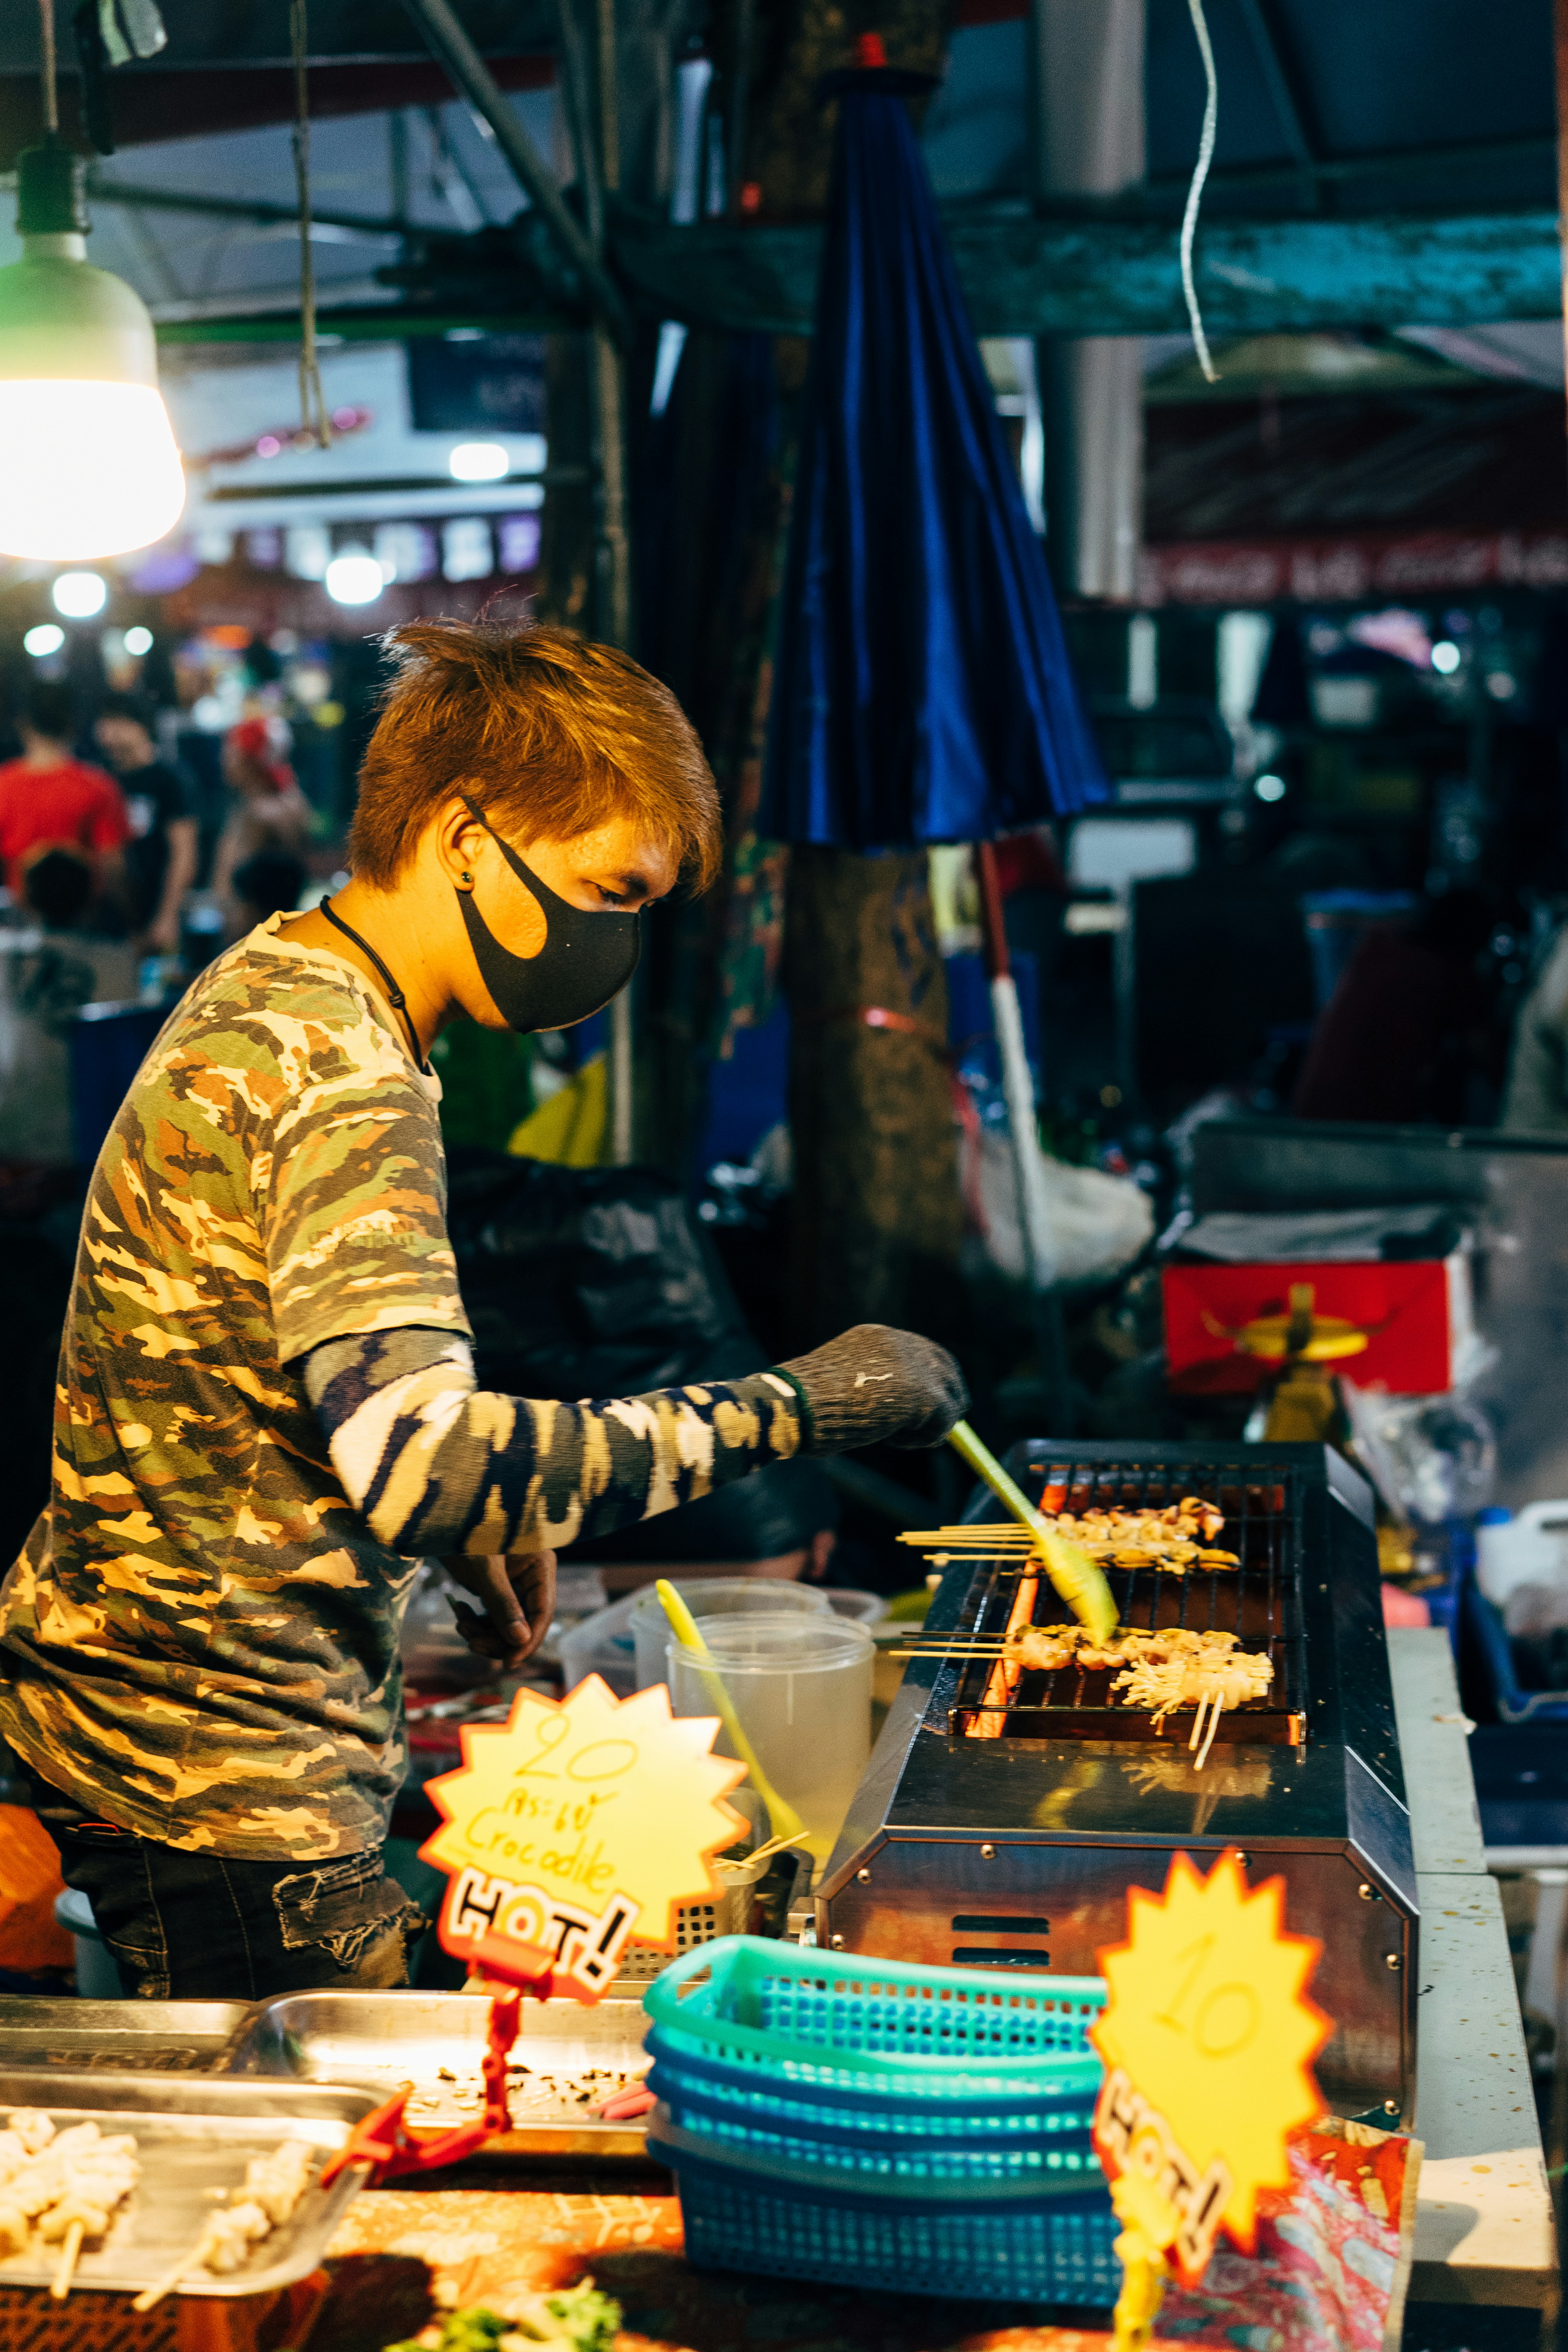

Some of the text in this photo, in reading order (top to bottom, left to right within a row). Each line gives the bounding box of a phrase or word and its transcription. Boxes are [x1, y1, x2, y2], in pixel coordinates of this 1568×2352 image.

[512, 1712, 639, 1783] 20
[453, 1871, 635, 1985] HOT!
[1149, 1931, 1263, 2061] 10
[1104, 2077, 1226, 2261] HOT!
